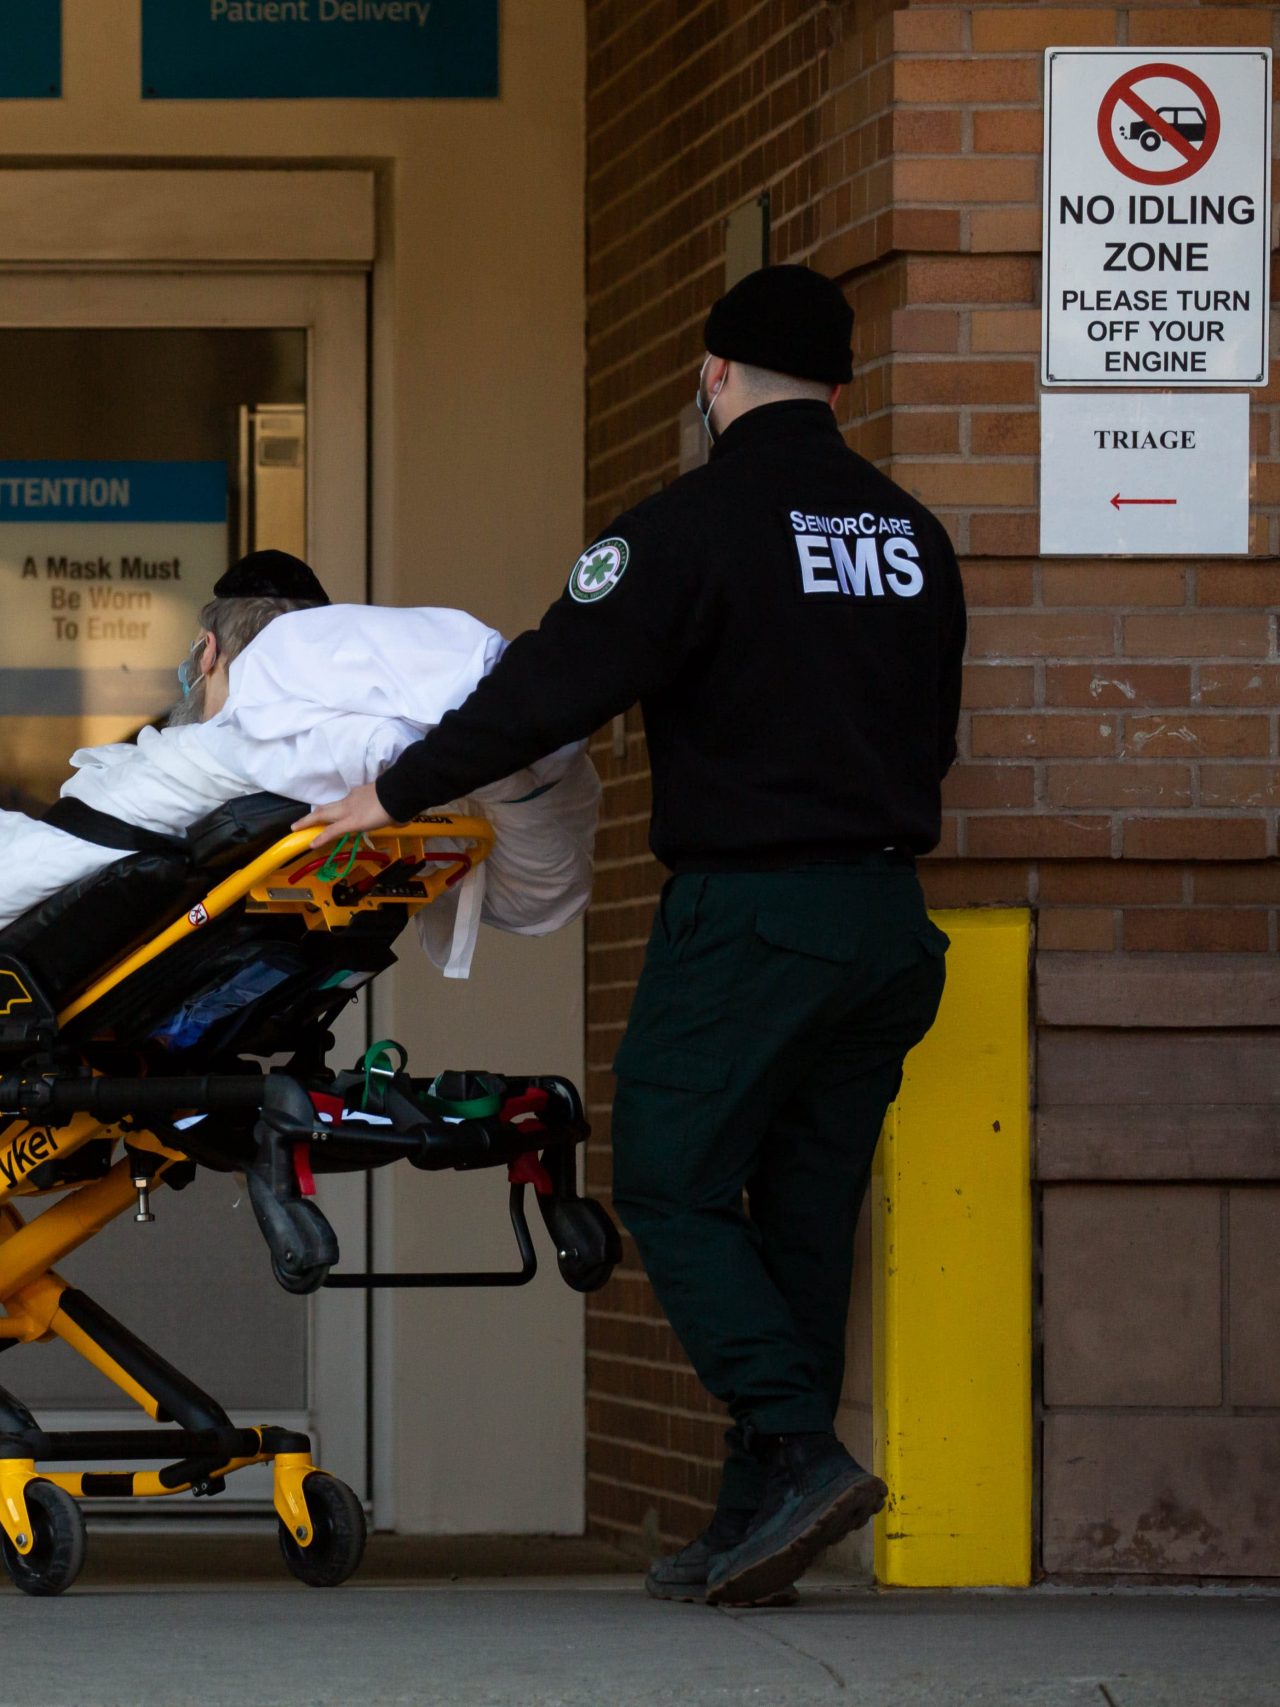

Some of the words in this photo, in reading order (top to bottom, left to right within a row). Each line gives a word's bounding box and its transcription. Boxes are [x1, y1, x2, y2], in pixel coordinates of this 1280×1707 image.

[210, 0, 312, 23] Patient
[320, 0, 432, 28] Delivery
[1060, 196, 1115, 225] NO
[1129, 196, 1255, 225] IDLING
[1103, 243, 1209, 272] ZONE
[1062, 290, 1168, 311] PLEASE
[1177, 290, 1250, 311] TURN
[1087, 321, 1140, 342] OFF
[1149, 321, 1225, 342] YOUR
[1105, 352, 1207, 372] ENGINE
[1094, 430, 1196, 450] TRIAGE
[22, 556, 38, 579] A
[47, 556, 113, 580] Mask
[121, 556, 182, 580] Must
[794, 534, 924, 597] EMS
[51, 587, 81, 610] Be
[89, 586, 151, 611] Worn
[53, 618, 79, 640] To
[87, 617, 151, 641] Enter
